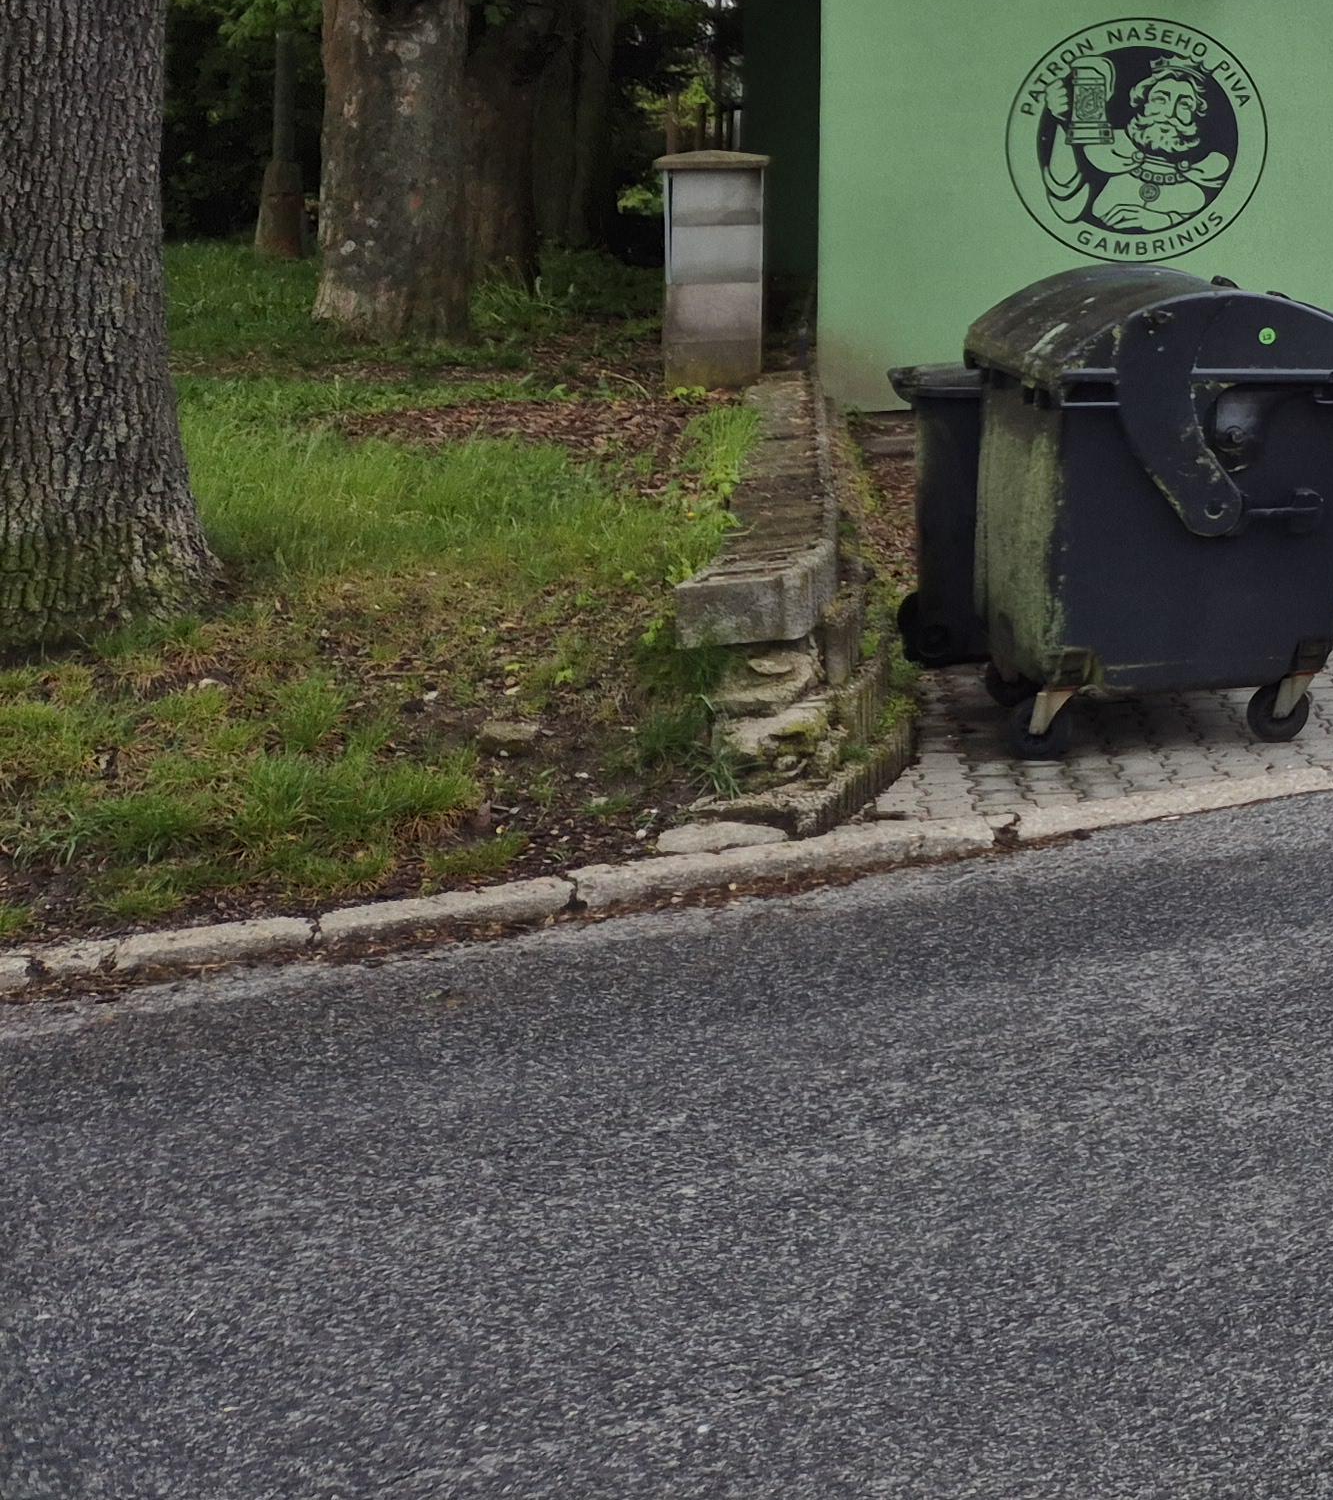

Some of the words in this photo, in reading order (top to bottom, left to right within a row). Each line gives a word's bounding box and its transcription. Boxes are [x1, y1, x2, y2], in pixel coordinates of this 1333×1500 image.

[1020, 37, 1094, 116] PATRON
[1106, 23, 1208, 57] NAŠEHO
[1211, 59, 1252, 108] PIVA
[1077, 211, 1224, 256] GAMBRINUS
